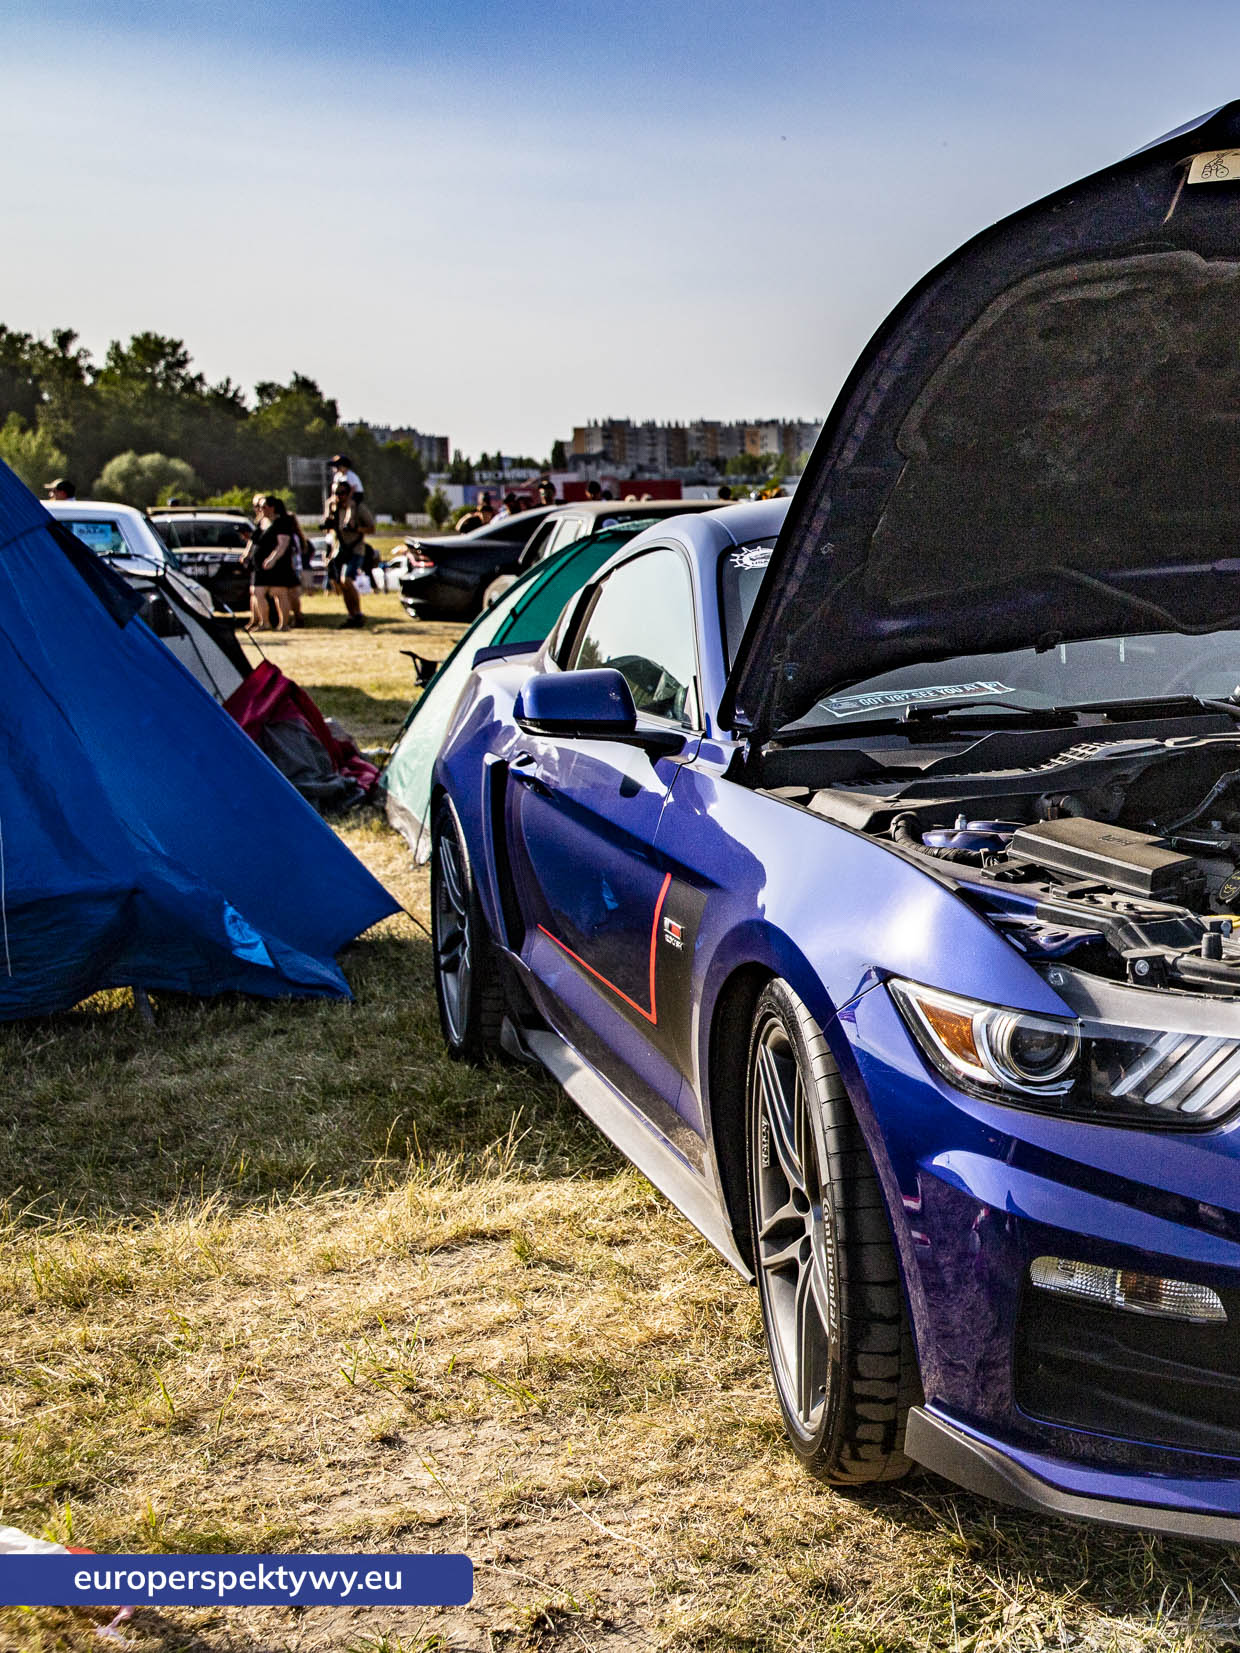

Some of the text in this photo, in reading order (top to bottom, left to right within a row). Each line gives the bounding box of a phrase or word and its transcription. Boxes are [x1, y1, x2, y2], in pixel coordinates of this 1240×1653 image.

[859, 696, 885, 706] GOT
[911, 690, 938, 698] SEE
[936, 686, 964, 695] YOU
[822, 1197, 838, 1330] Continental
